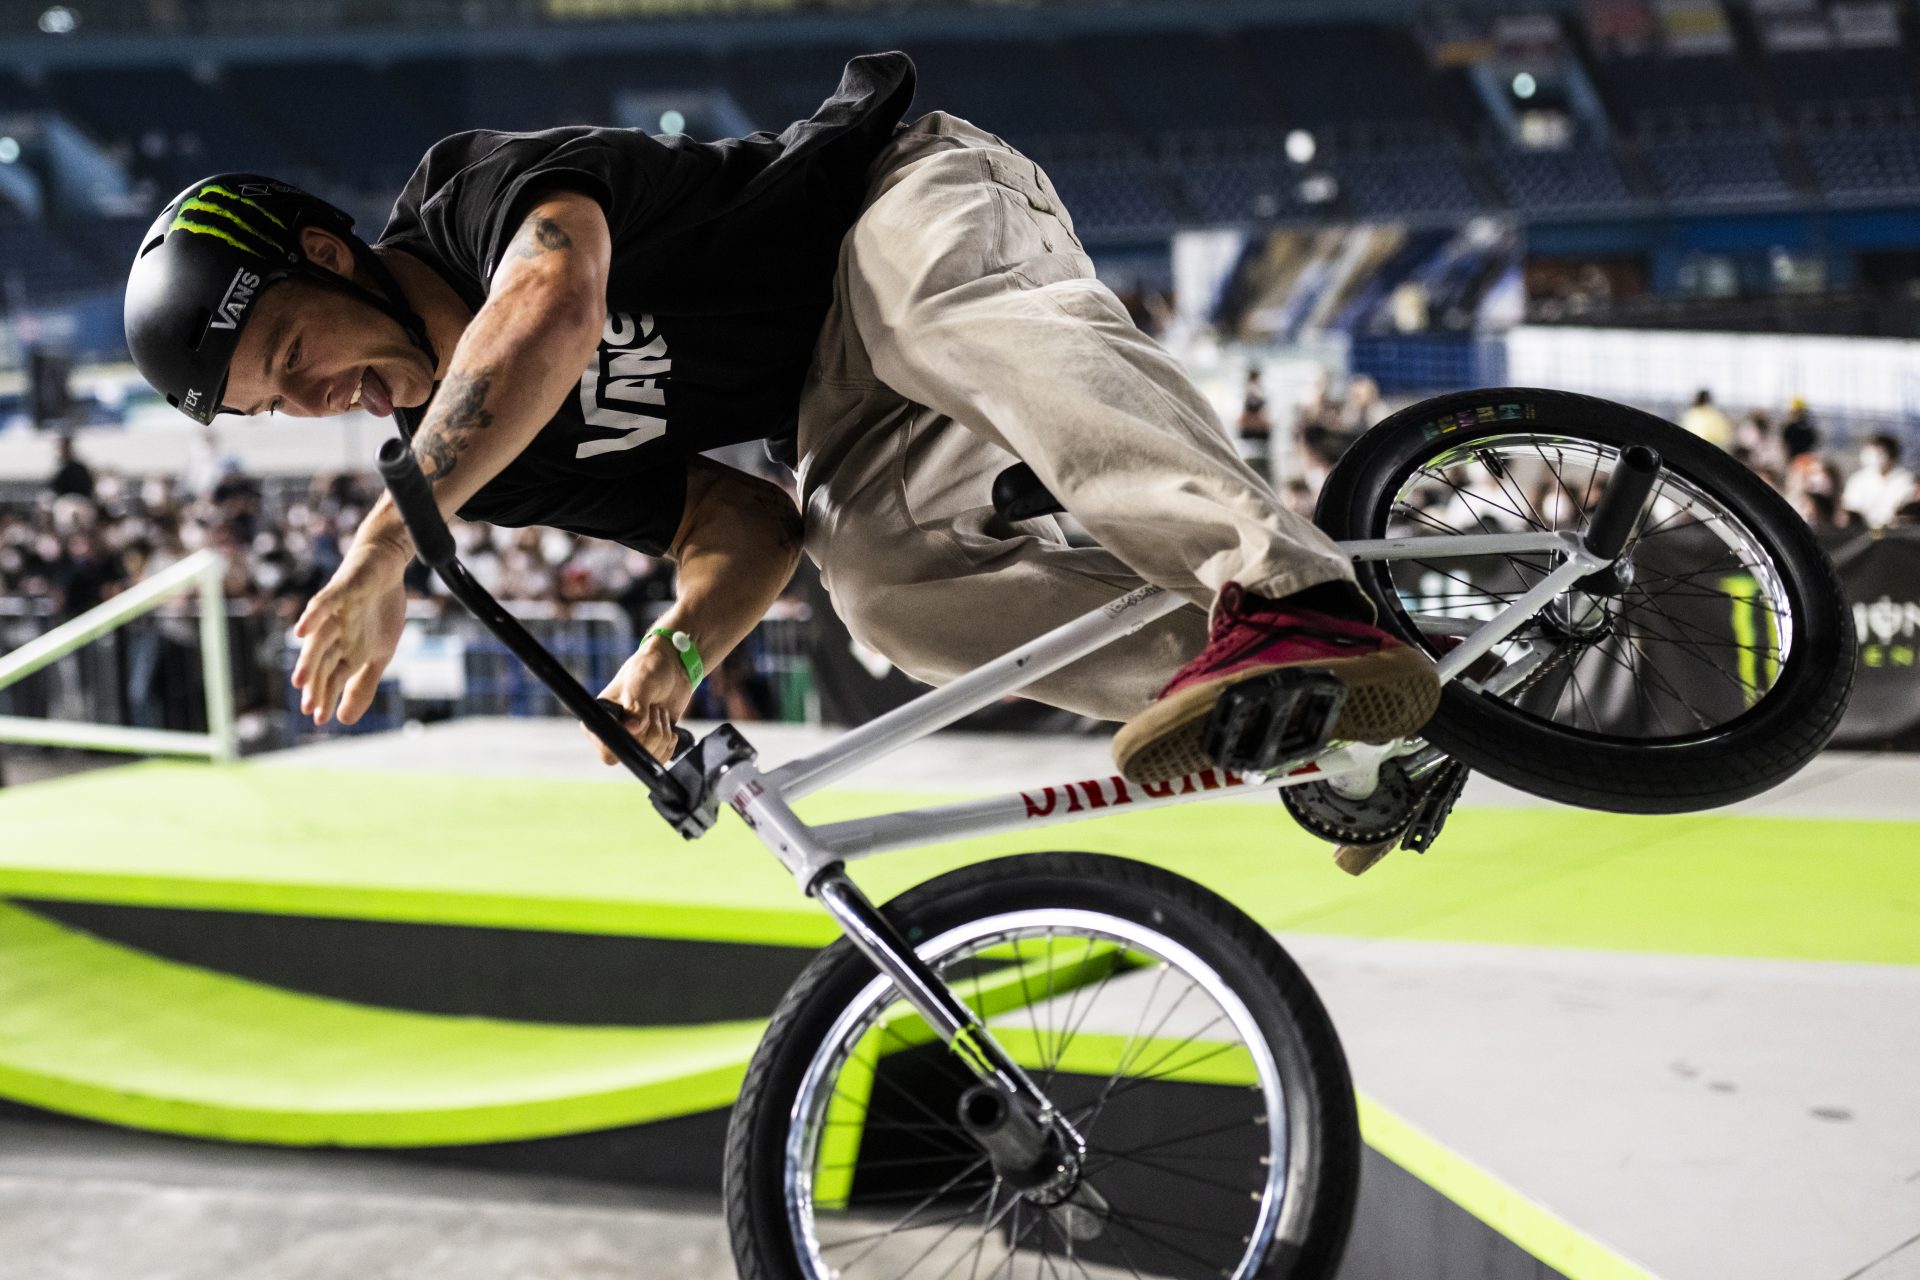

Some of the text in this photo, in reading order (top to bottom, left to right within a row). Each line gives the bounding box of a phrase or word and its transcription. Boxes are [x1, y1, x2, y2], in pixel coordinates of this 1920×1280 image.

[211, 267, 260, 331] VANS
[182, 388, 202, 417] TER
[575, 312, 672, 459] VANS
